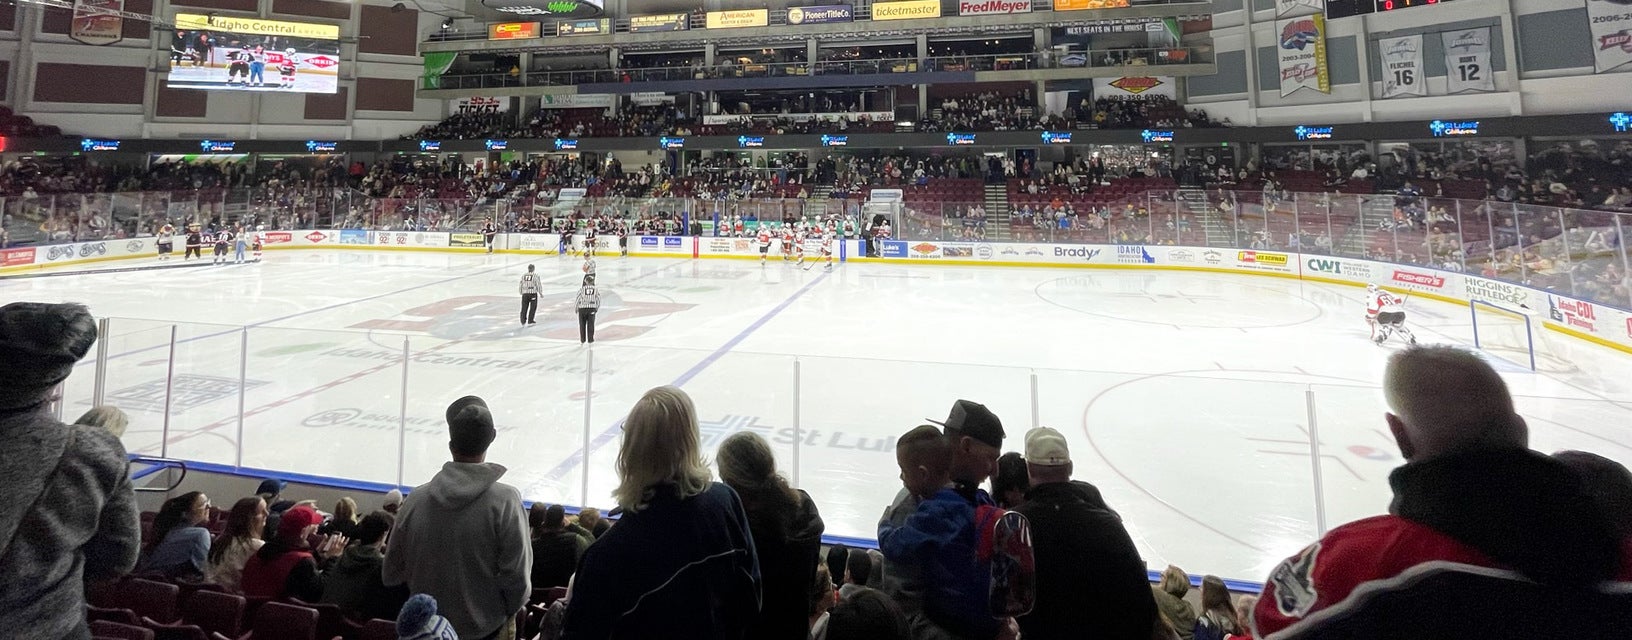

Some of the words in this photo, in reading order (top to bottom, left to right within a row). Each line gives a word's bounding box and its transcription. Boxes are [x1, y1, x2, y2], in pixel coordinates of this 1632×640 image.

[876, 5, 936, 16] ticketmaster
[961, 1, 1028, 13] FredMeyer
[216, 18, 249, 30] Idaho
[252, 22, 296, 33] Central
[1083, 26, 1102, 34] SEATS
[1394, 70, 1413, 86] 16
[1458, 64, 1480, 81] 12
[459, 105, 499, 114] TICKET
[581, 240, 609, 249] Splot
[1118, 246, 1141, 254] IDAHO
[1054, 246, 1093, 260] Brady
[1308, 258, 1341, 273] CWI
[1396, 273, 1441, 285] FISHER'S
[1465, 277, 1511, 294] HIGGINS
[1466, 286, 1520, 304] RUTLEDGE
[1558, 297, 1576, 312] Idaho
[1576, 301, 1596, 320] CDL
[414, 352, 538, 370] Central
[772, 426, 822, 446] St
